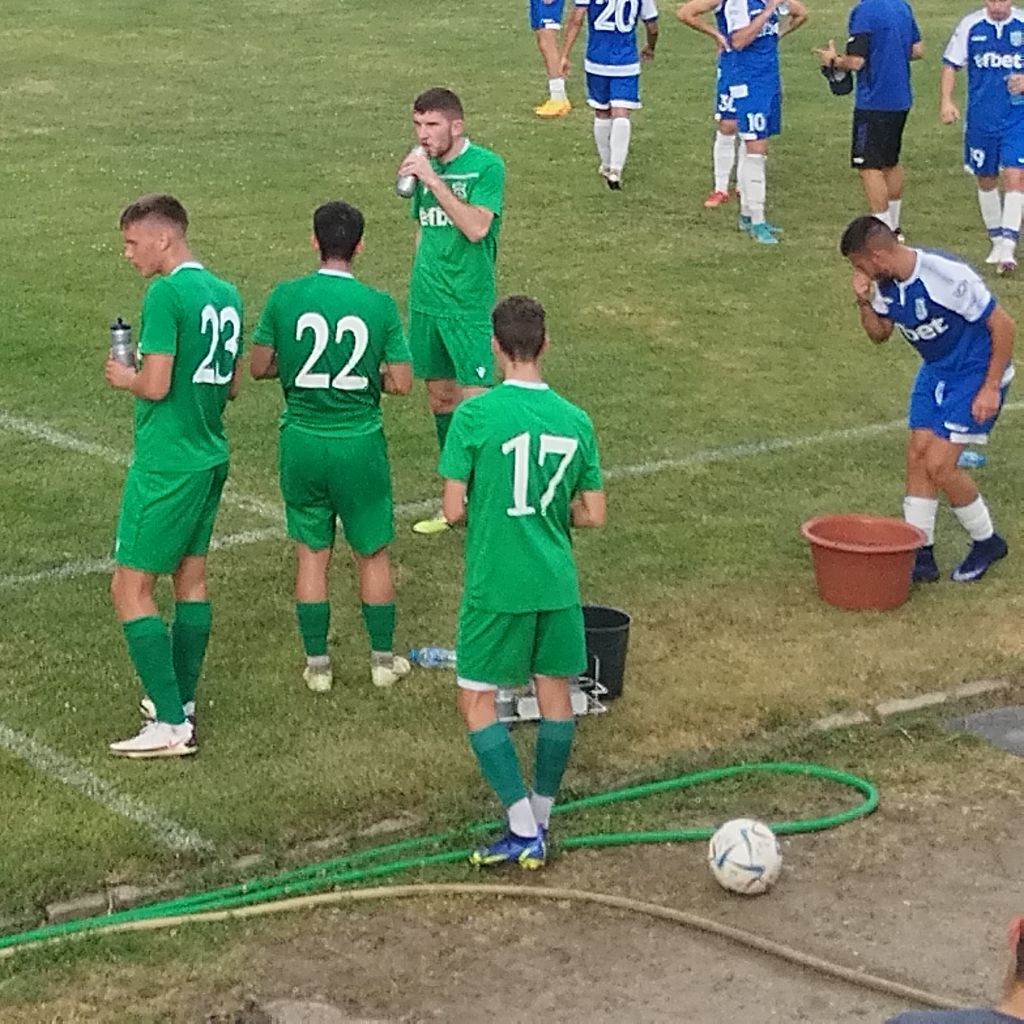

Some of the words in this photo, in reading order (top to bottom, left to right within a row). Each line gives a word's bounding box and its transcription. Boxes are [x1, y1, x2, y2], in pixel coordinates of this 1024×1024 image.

[746, 112, 766, 132] 10
[419, 207, 453, 227] efb
[193, 304, 242, 385] 23
[294, 312, 369, 390] 22
[895, 317, 950, 342] bet
[501, 432, 578, 517] 17
